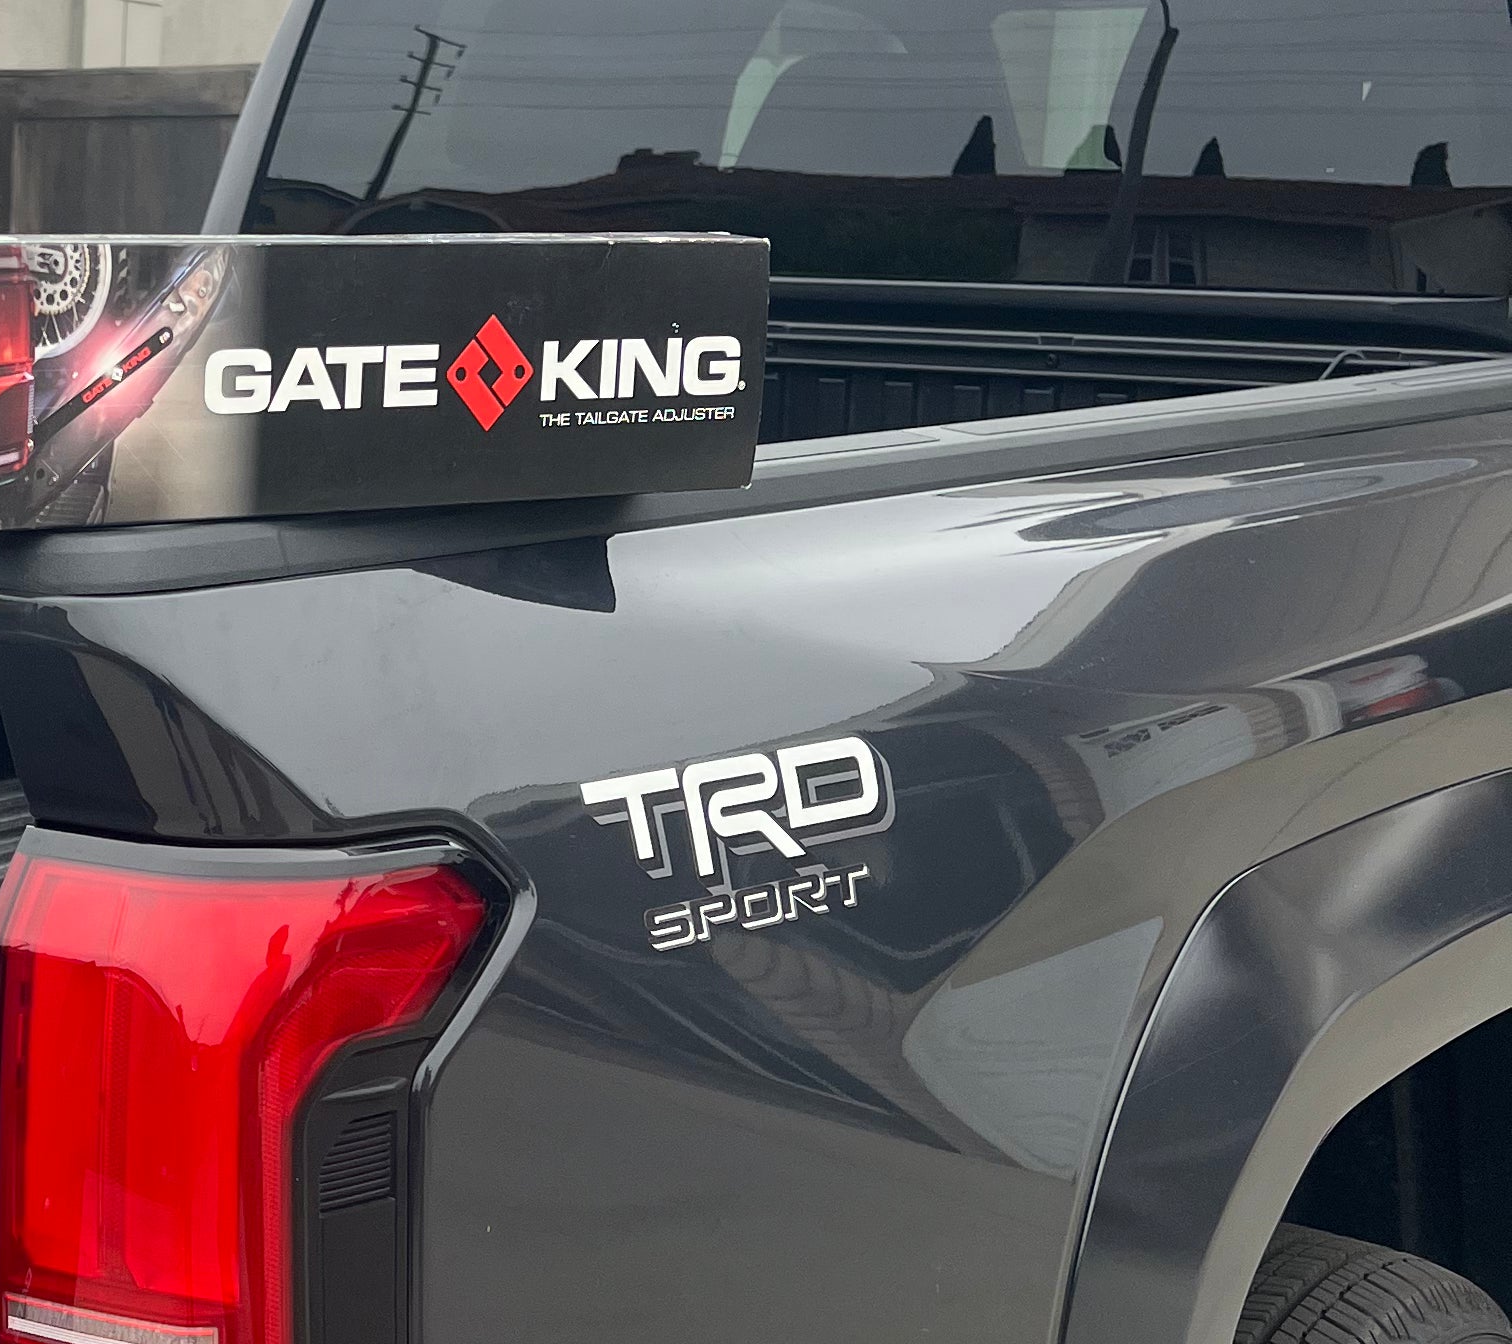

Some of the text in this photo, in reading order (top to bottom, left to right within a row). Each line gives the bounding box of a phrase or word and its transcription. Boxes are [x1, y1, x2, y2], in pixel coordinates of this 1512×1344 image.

[204, 336, 742, 414] GATE KING
[539, 406, 735, 427] THE TAILGATE ADJUSTER
[580, 736, 880, 877] TRD
[643, 863, 871, 952] SPORT
